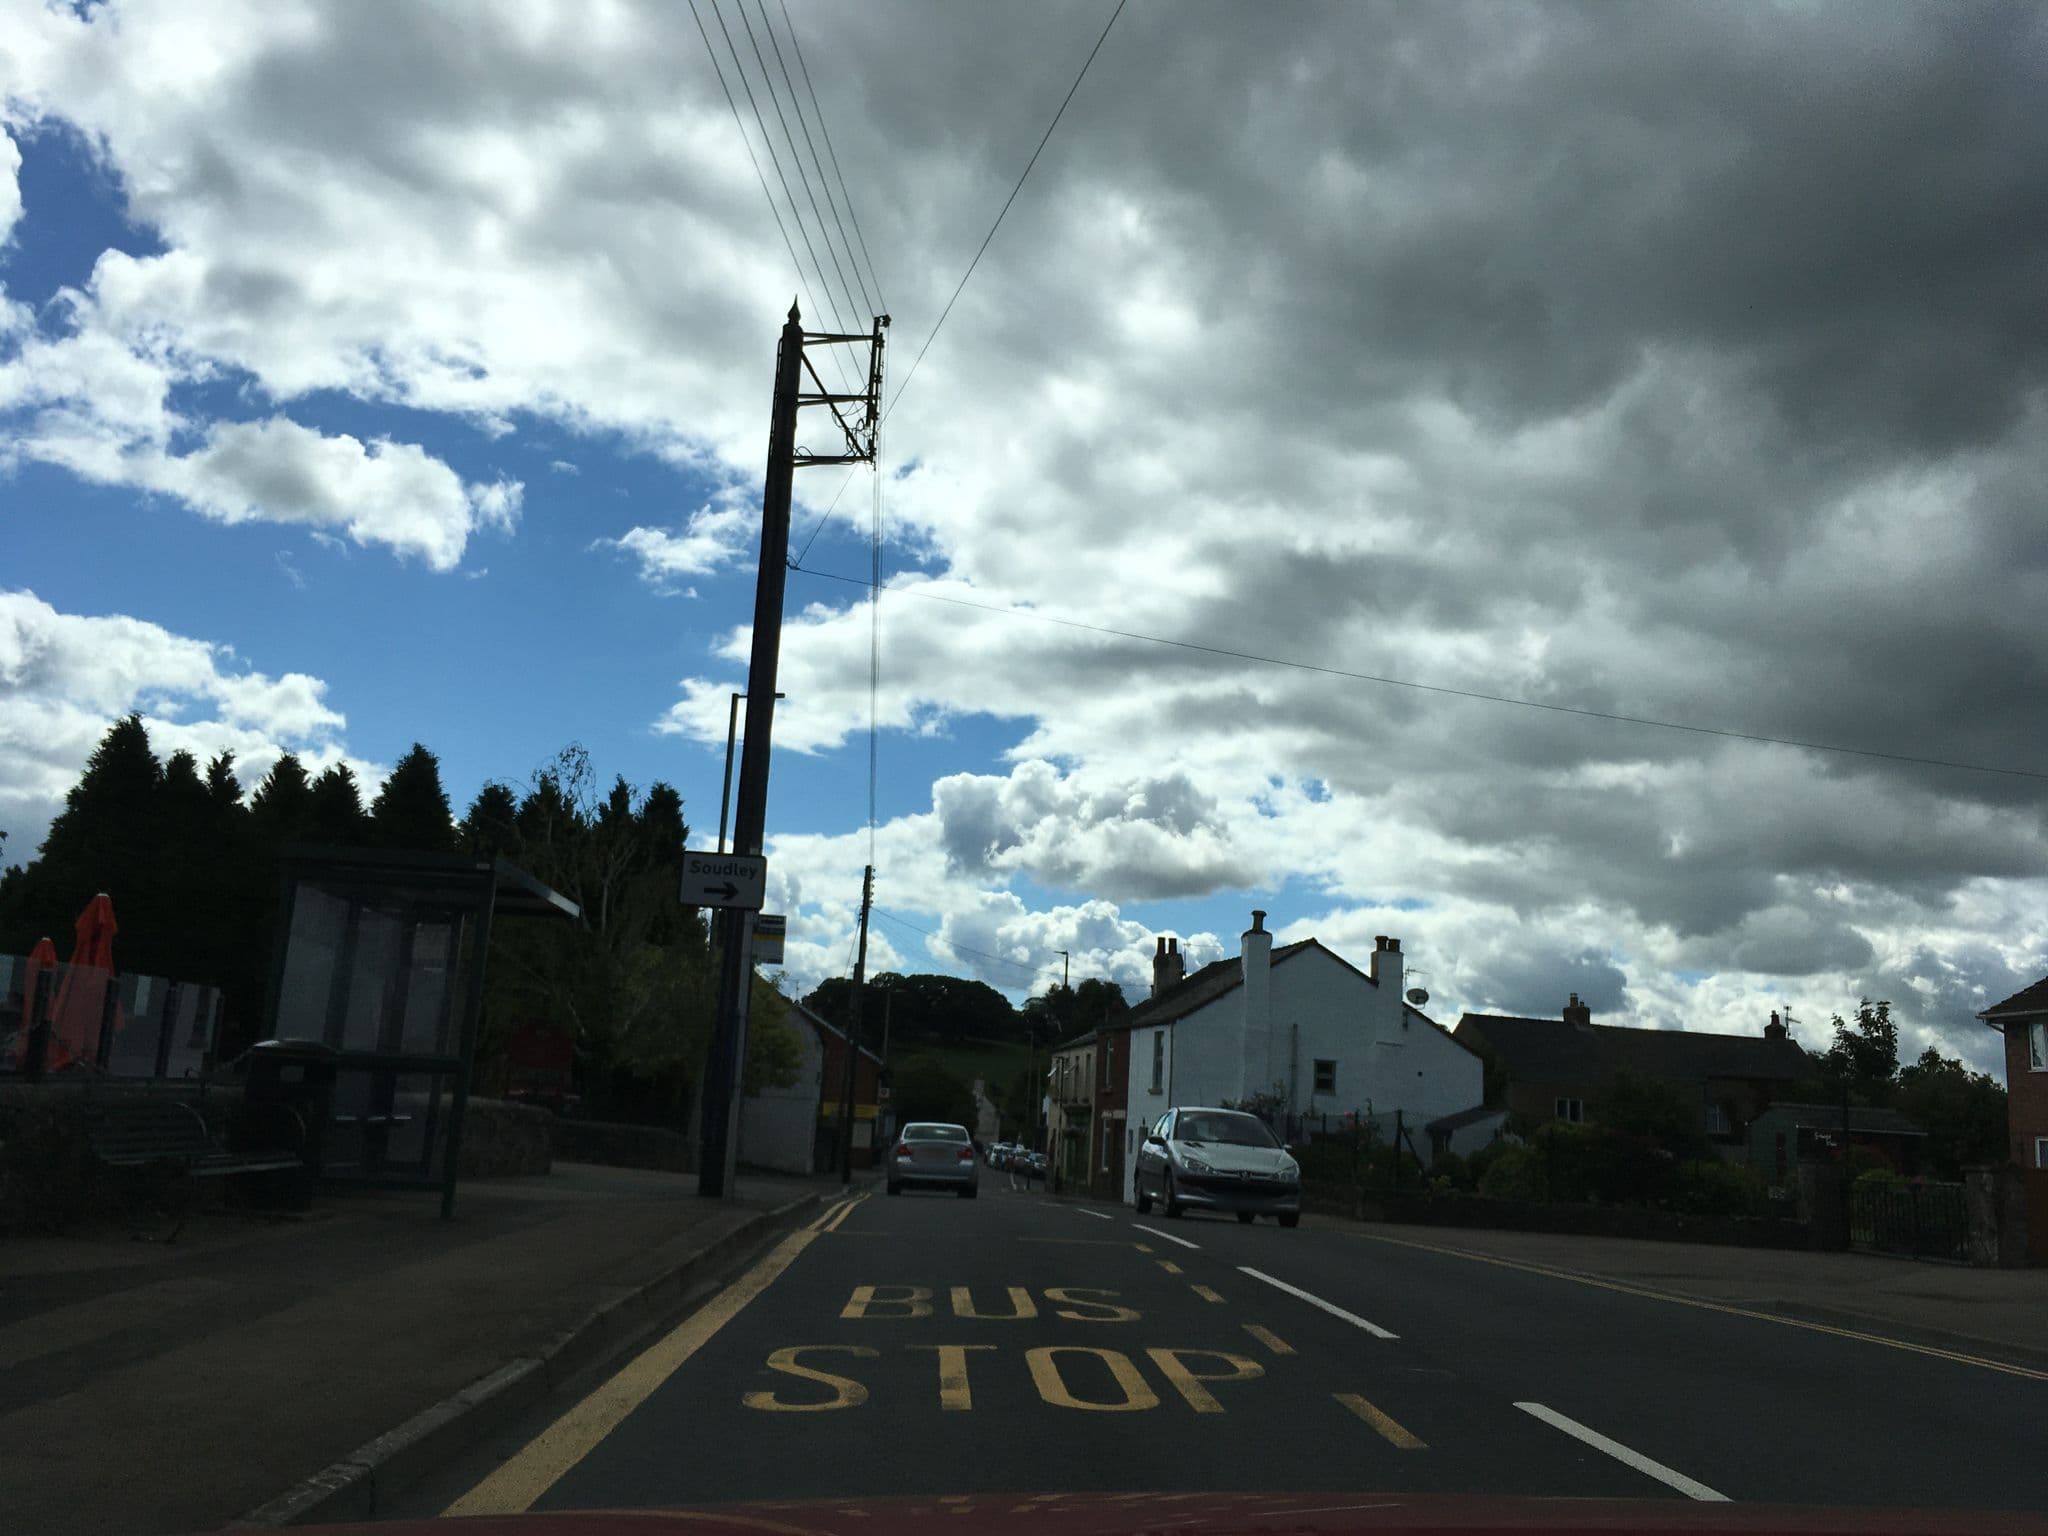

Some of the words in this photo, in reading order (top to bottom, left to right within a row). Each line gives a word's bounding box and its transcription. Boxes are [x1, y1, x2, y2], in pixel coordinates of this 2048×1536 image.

[690, 860, 757, 879] Soudley
[839, 1286, 1142, 1322] BUS
[742, 1345, 1266, 1413] STOP
